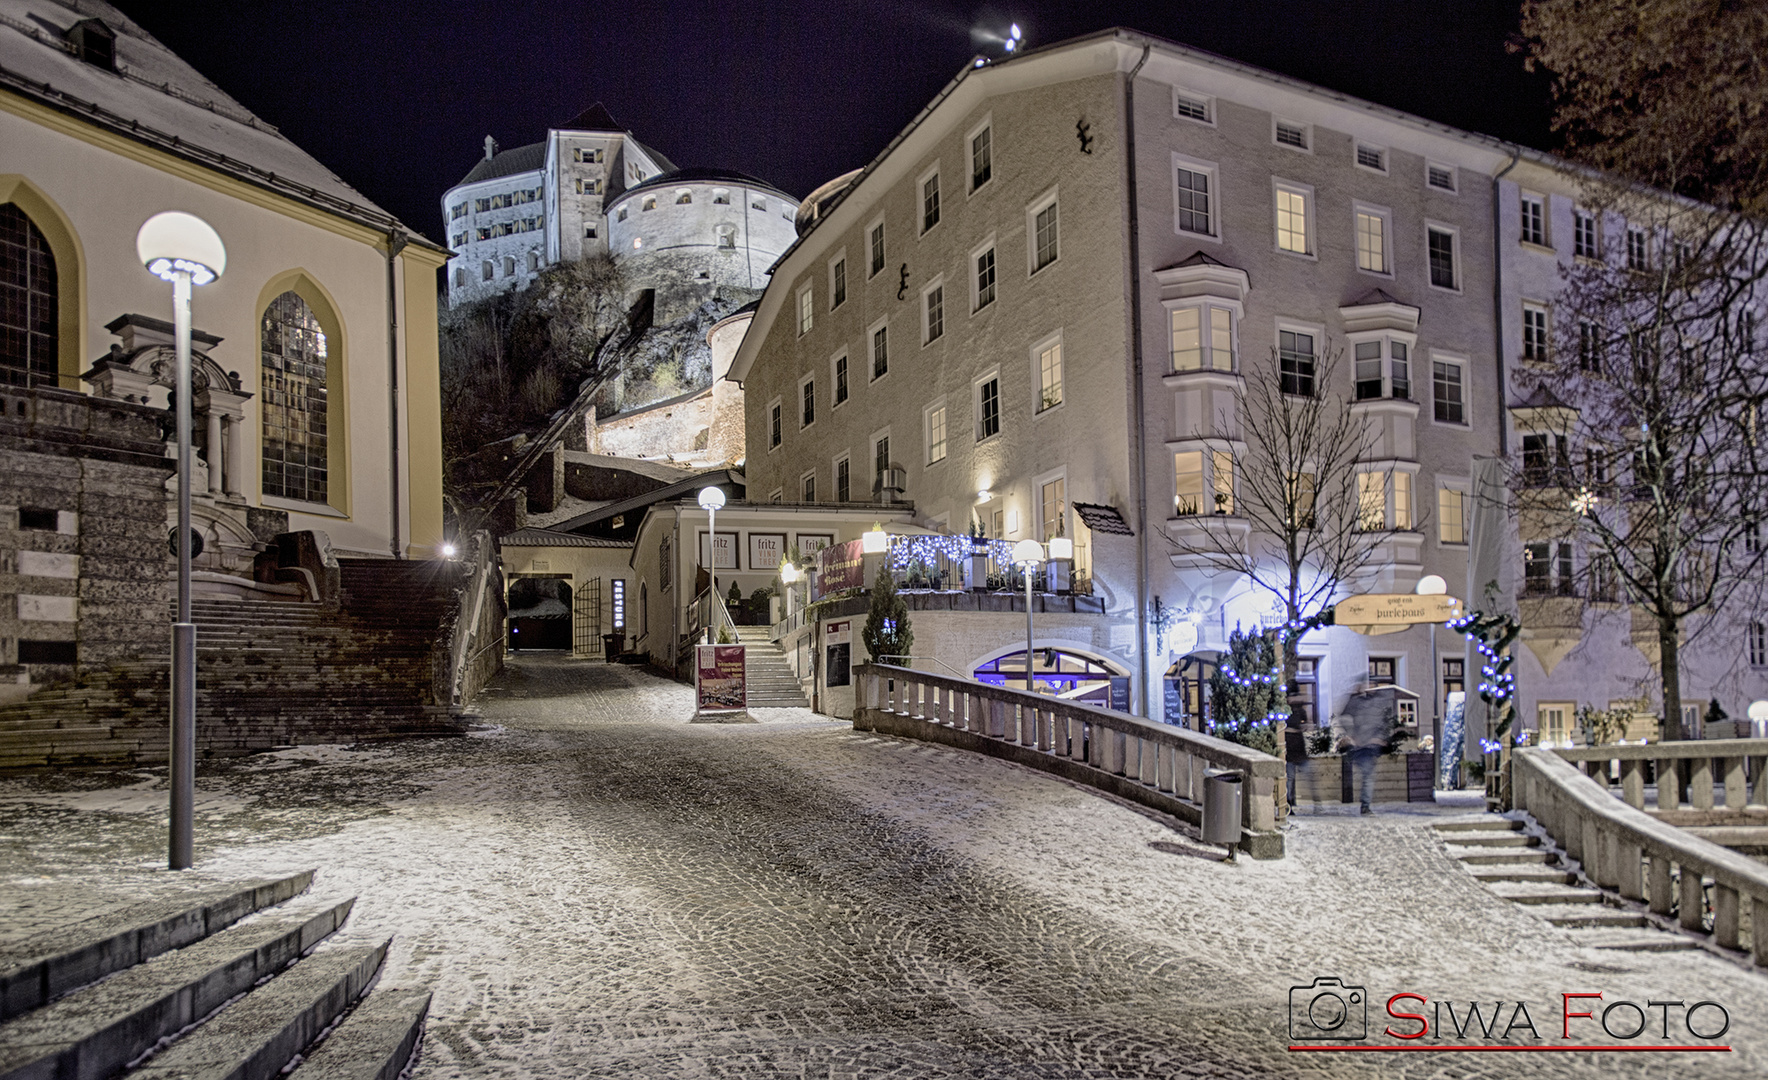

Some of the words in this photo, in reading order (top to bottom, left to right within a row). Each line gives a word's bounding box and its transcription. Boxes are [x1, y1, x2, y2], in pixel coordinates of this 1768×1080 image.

[713, 537, 728, 548] ritz
[758, 538, 776, 550] fritz
[805, 540, 819, 550] frit
[758, 550, 777, 558] VINO
[713, 557, 728, 565] AFE
[614, 581, 623, 627] FESTUNG
